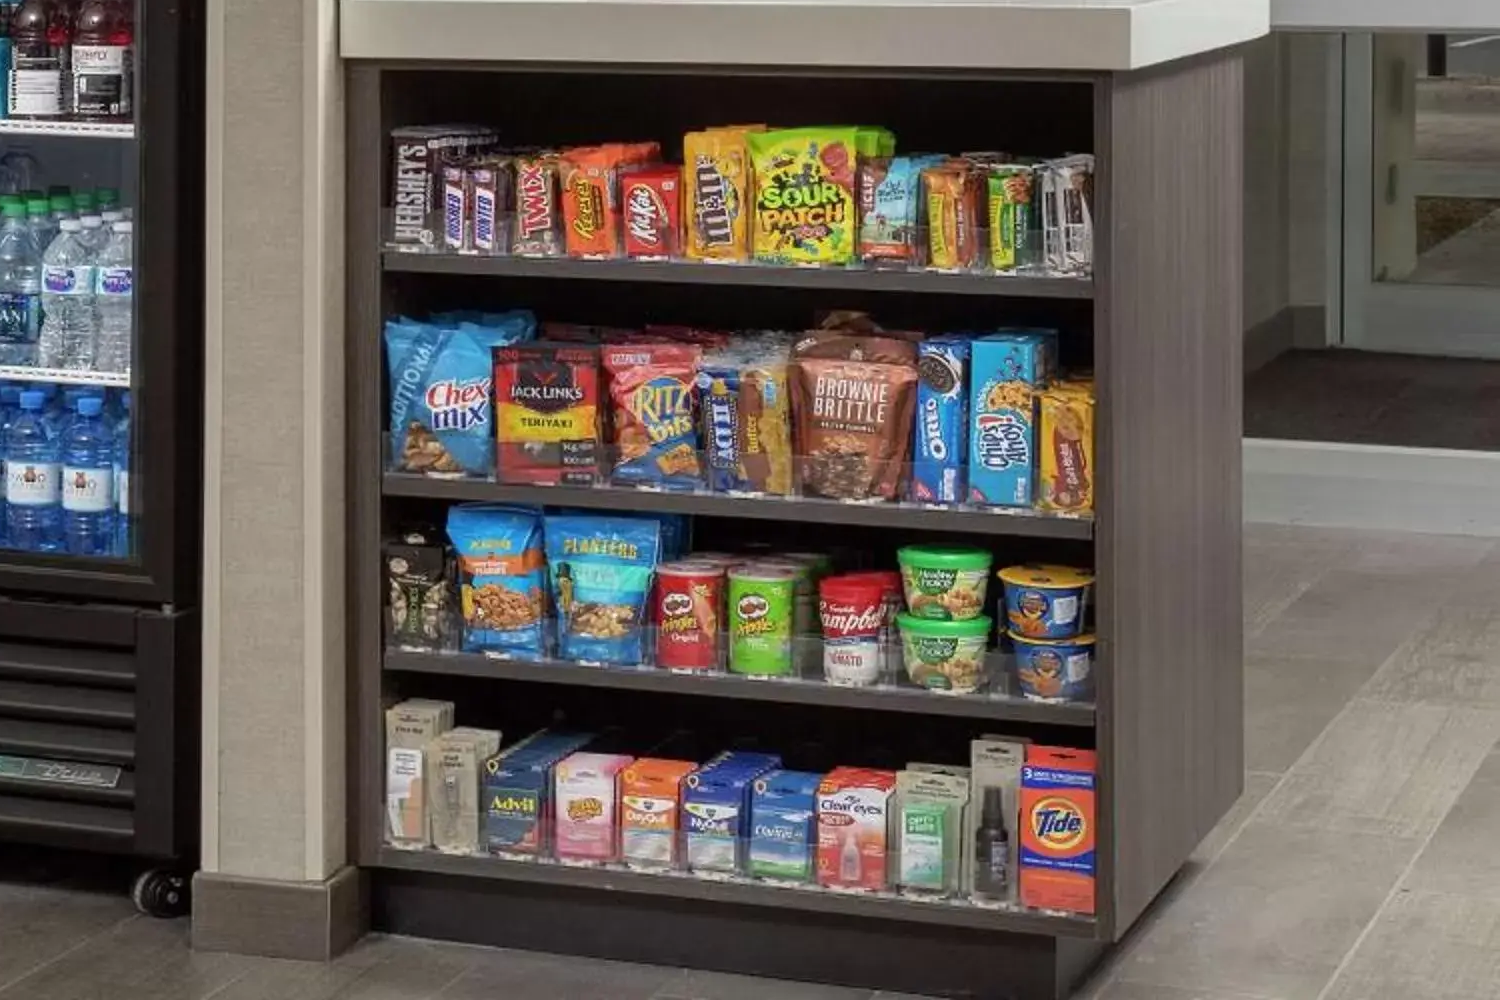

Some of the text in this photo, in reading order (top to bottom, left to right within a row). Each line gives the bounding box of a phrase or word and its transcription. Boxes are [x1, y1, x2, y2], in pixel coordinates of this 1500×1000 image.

[394, 144, 427, 240] HERSHEY'S
[520, 165, 552, 240] TWIX
[762, 183, 840, 209] SOUR
[861, 172, 875, 204] CLIF
[760, 202, 846, 234] PATCH
[426, 378, 491, 408] Chex
[510, 384, 584, 401] JACK LINK'S
[631, 383, 692, 426] RITZ
[815, 376, 889, 404] BROWNIE
[433, 400, 487, 431] mix
[520, 416, 574, 429] TERIYAKI
[812, 397, 886, 424] BRITTLE
[647, 412, 694, 443] bits
[746, 412, 761, 453] Butter
[925, 397, 948, 461] OREO
[714, 426, 735, 461] ACT
[978, 424, 1009, 470] Chips
[563, 537, 640, 561] PLANTERS
[490, 795, 536, 813] Advil
[820, 799, 884, 819] Clear eyes
[1034, 808, 1083, 839] Tide
